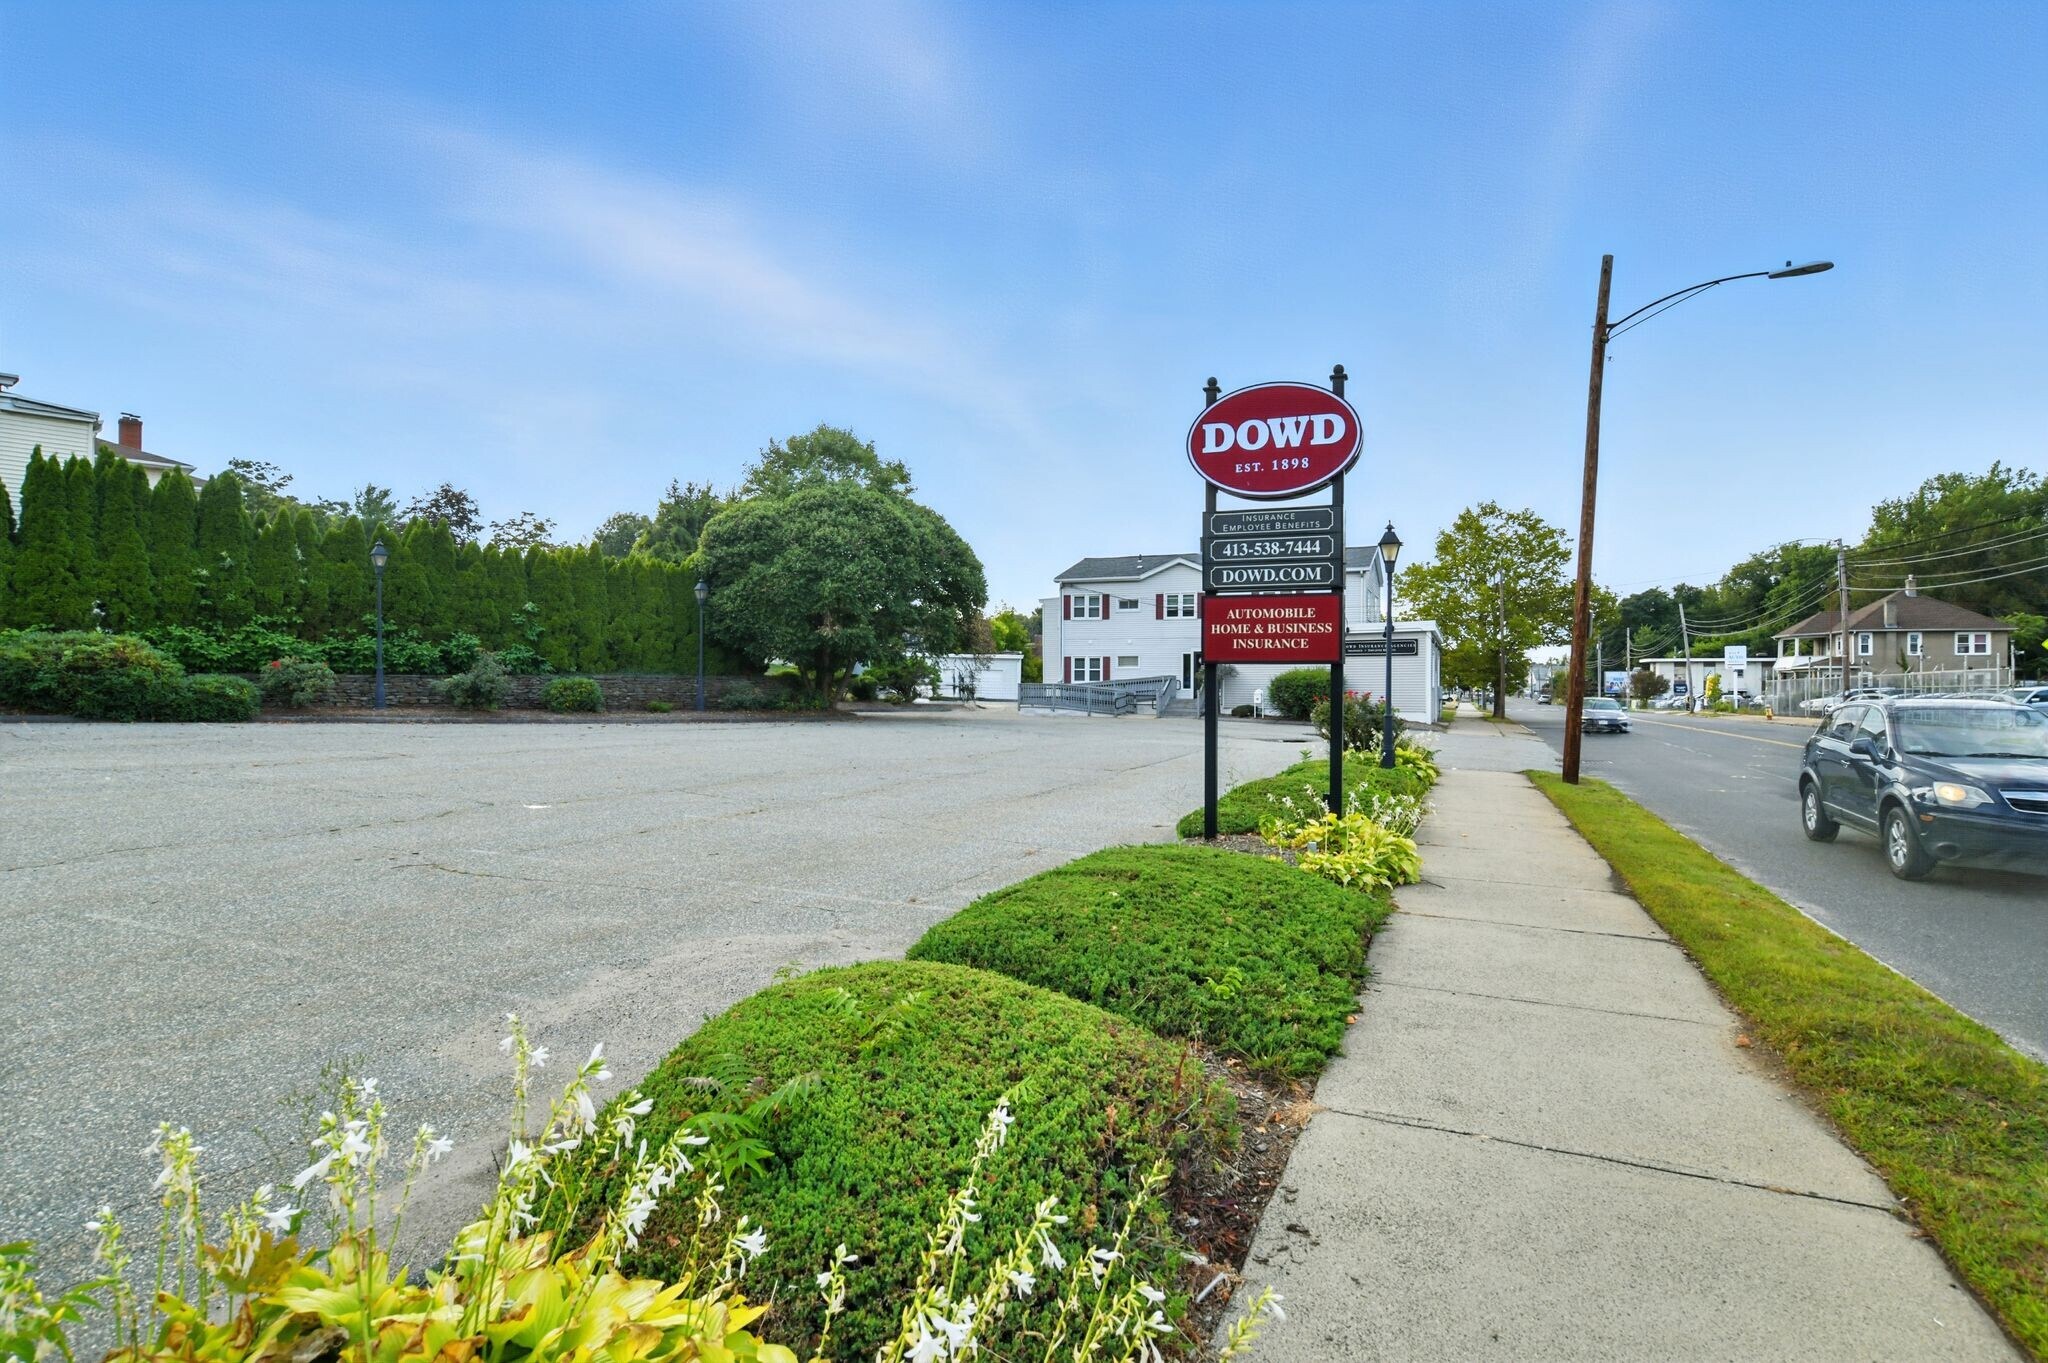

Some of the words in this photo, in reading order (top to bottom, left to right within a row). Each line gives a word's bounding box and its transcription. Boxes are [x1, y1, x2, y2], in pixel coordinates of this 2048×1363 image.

[1202, 413, 1346, 454] DOWD
[1235, 462, 1265, 473] EST.
[1272, 457, 1310, 471] 1898
[1242, 513, 1295, 522] INSURANCE
[1222, 523, 1271, 532] EMPLOYEE
[1275, 521, 1320, 530] BENEFITS
[1222, 539, 1321, 557] 413-538-7444
[1222, 566, 1322, 583] DOWD.COM
[1226, 607, 1316, 619] AUTOMOBILE
[1211, 623, 1251, 635] HOME
[1253, 623, 1264, 634] &
[1267, 622, 1333, 634] BUSINESS
[1232, 638, 1310, 649] INSURANCE
